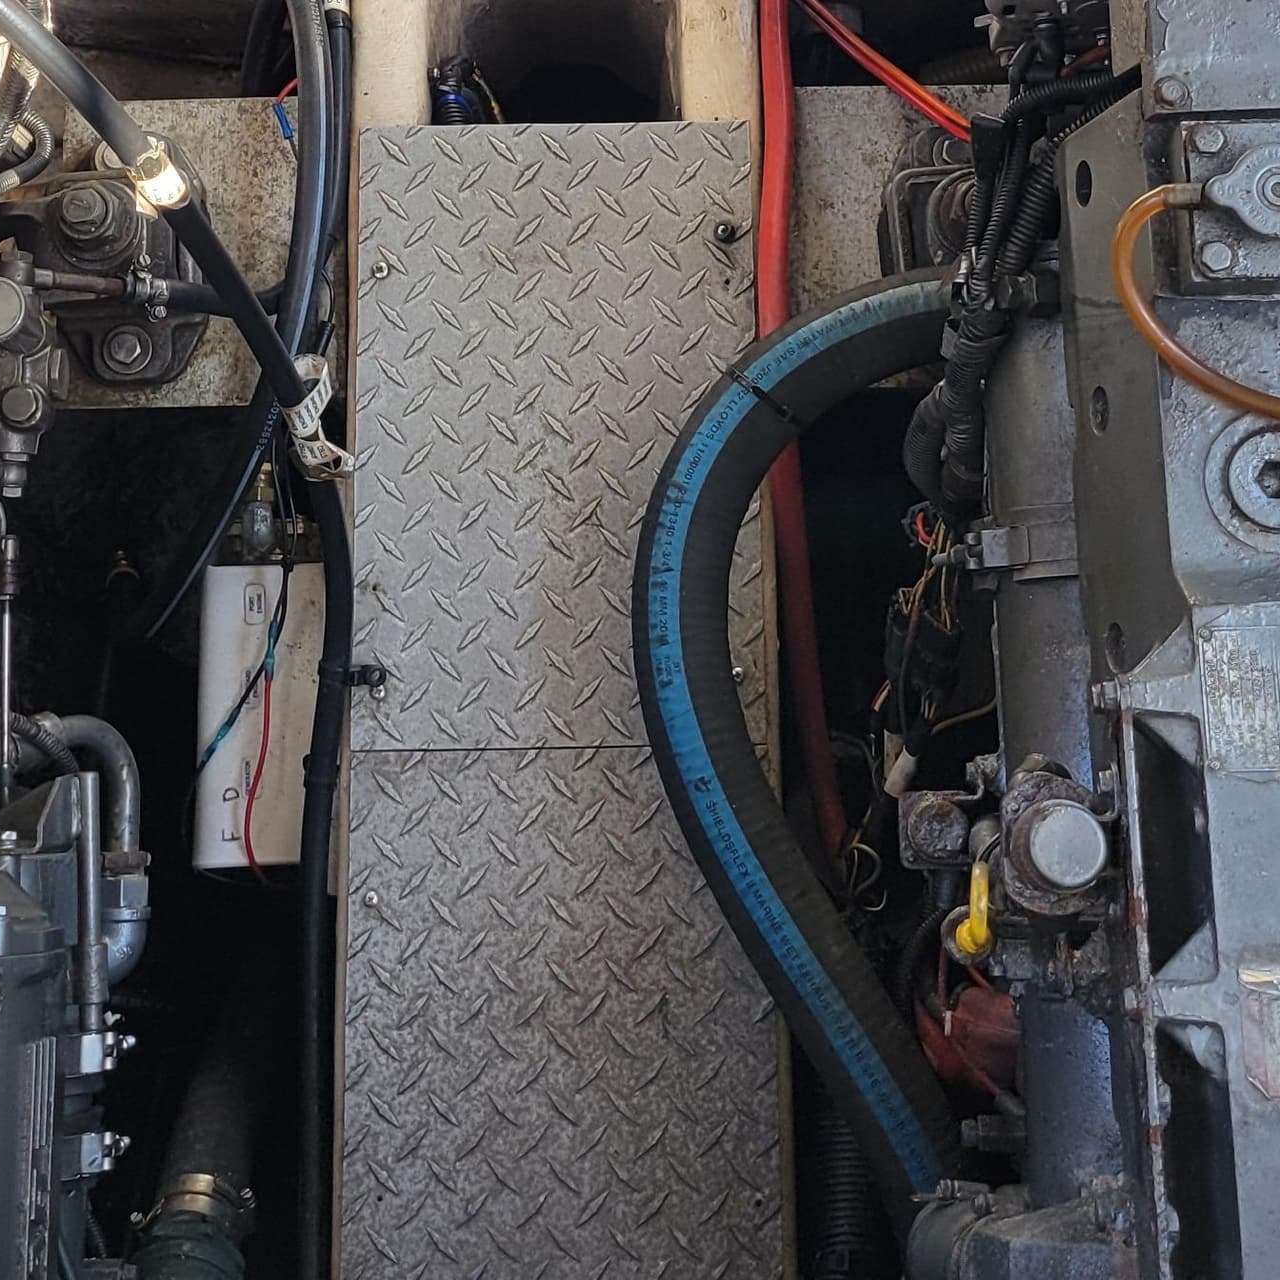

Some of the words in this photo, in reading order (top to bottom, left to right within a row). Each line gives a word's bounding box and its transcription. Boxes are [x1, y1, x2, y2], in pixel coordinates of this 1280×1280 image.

[705, 397, 739, 441] LLOYDS
[222, 787, 240, 802] D
[704, 798, 750, 879] SHIELDSFLEX
[750, 886, 784, 935] MARINE
[778, 931, 801, 963] WET
